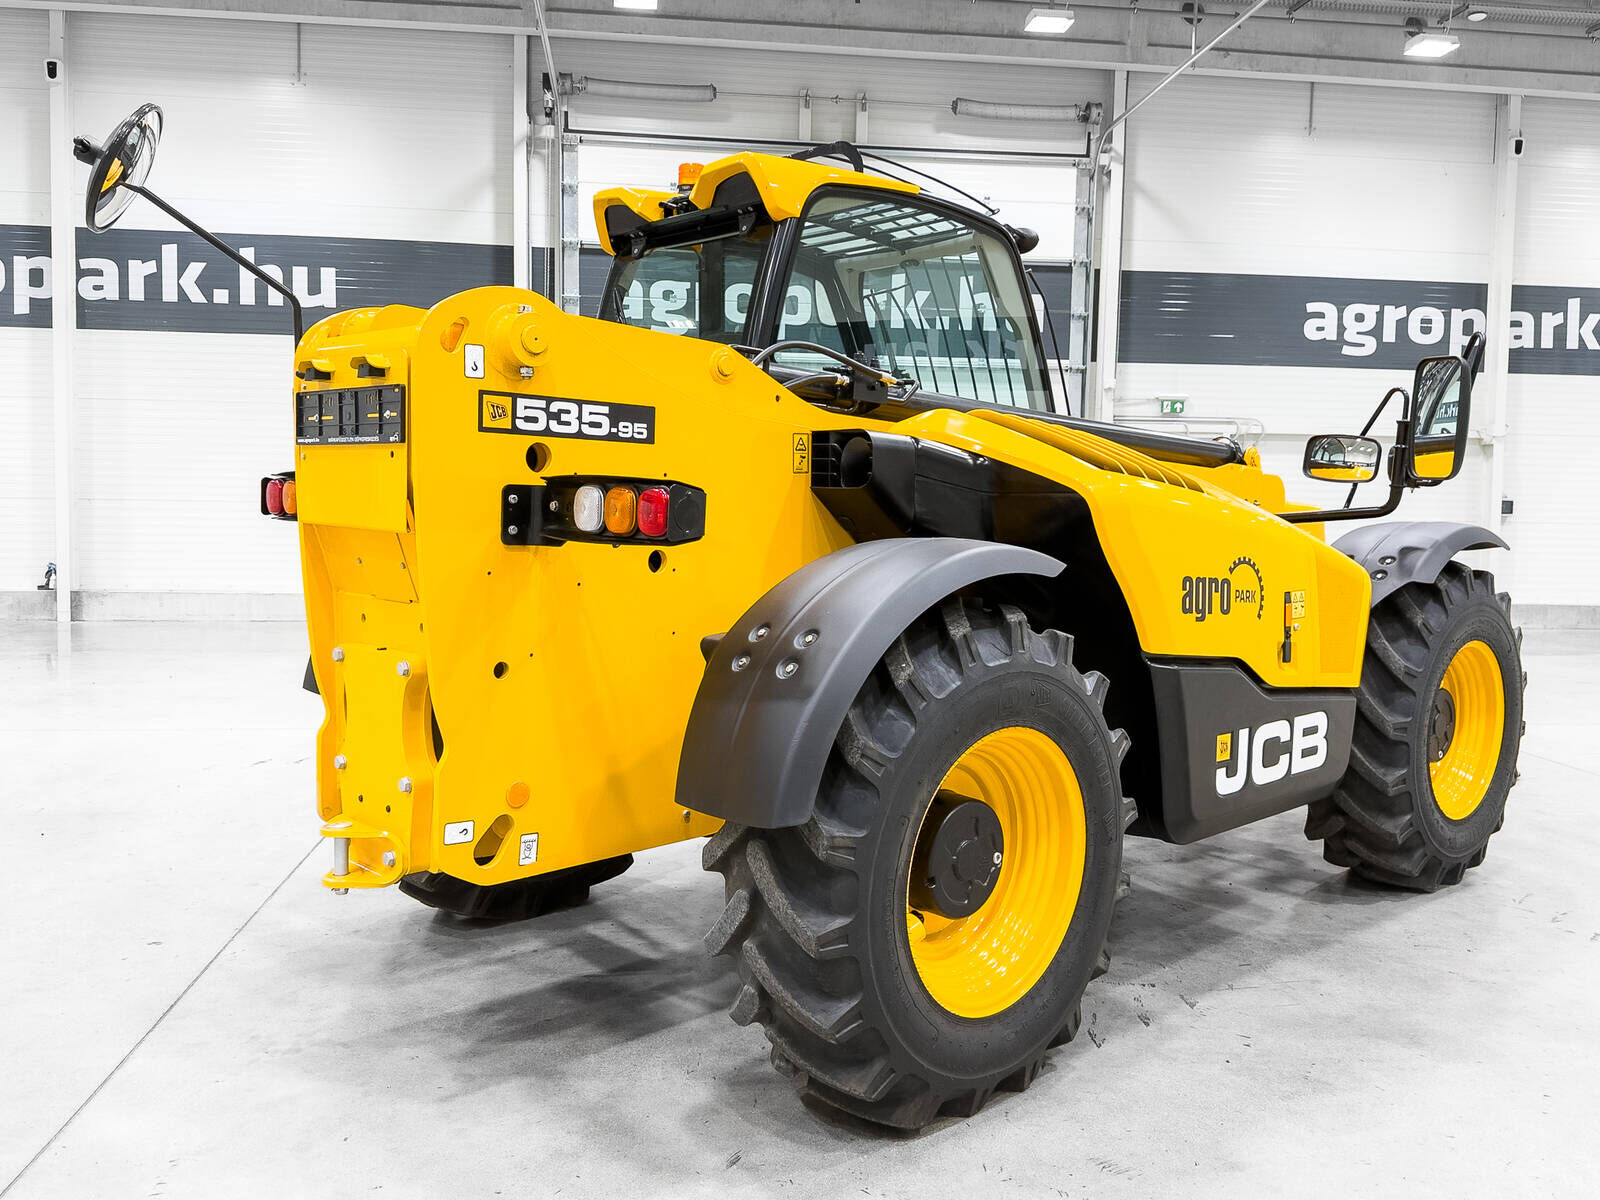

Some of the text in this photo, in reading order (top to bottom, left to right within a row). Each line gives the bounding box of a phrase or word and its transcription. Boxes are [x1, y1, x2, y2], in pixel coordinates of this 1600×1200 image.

[0, 243, 336, 315] park.hu
[490, 397, 648, 439] JCB 535-95
[1181, 575, 1257, 622] agro PARK
[1216, 711, 1328, 796] JCB
